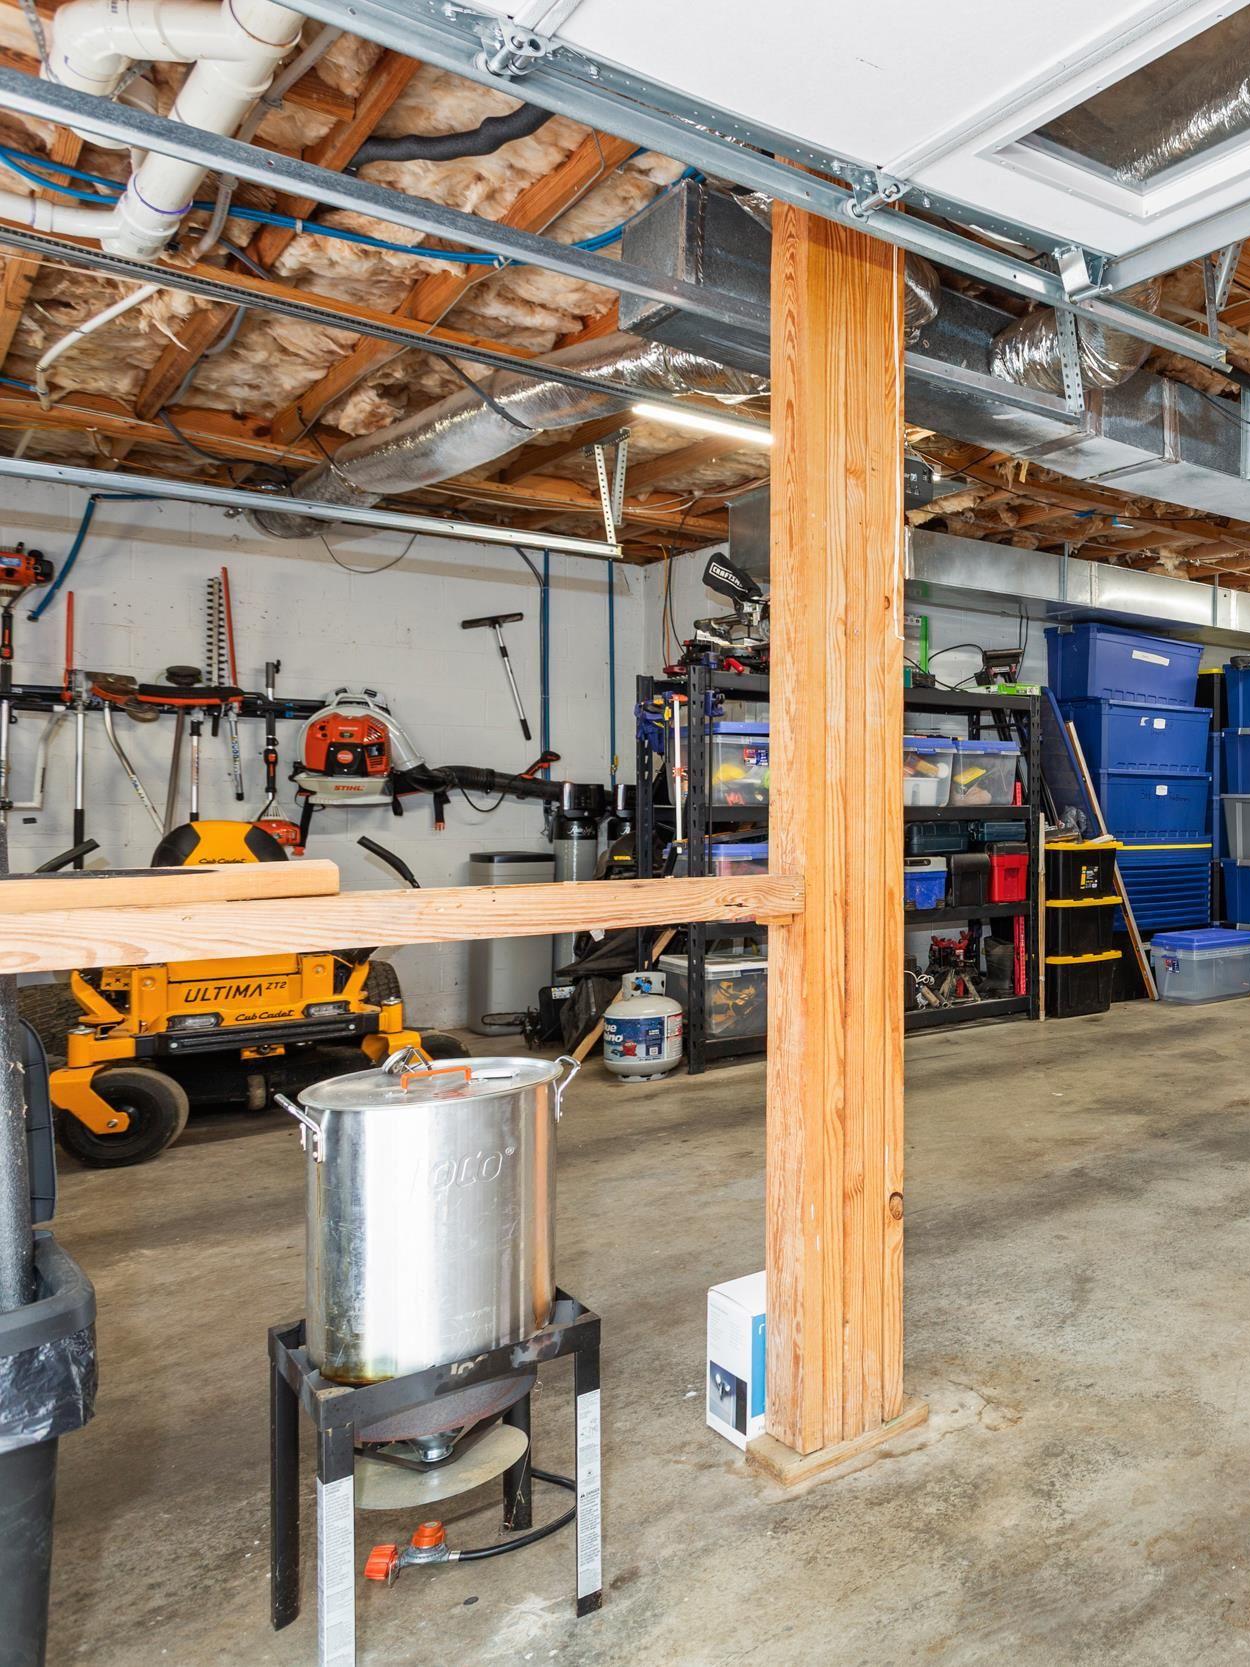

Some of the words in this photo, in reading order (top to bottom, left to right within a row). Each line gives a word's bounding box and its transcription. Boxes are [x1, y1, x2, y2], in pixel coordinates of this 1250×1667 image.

[712, 566, 743, 588] CRAFTSM
[334, 784, 366, 792] STIHL
[185, 984, 263, 1003] ULTIMA
[266, 981, 287, 990] ZT2
[235, 1013, 258, 1022] Cub
[258, 1009, 294, 1020] Cadet
[604, 1024, 617, 1033] ue
